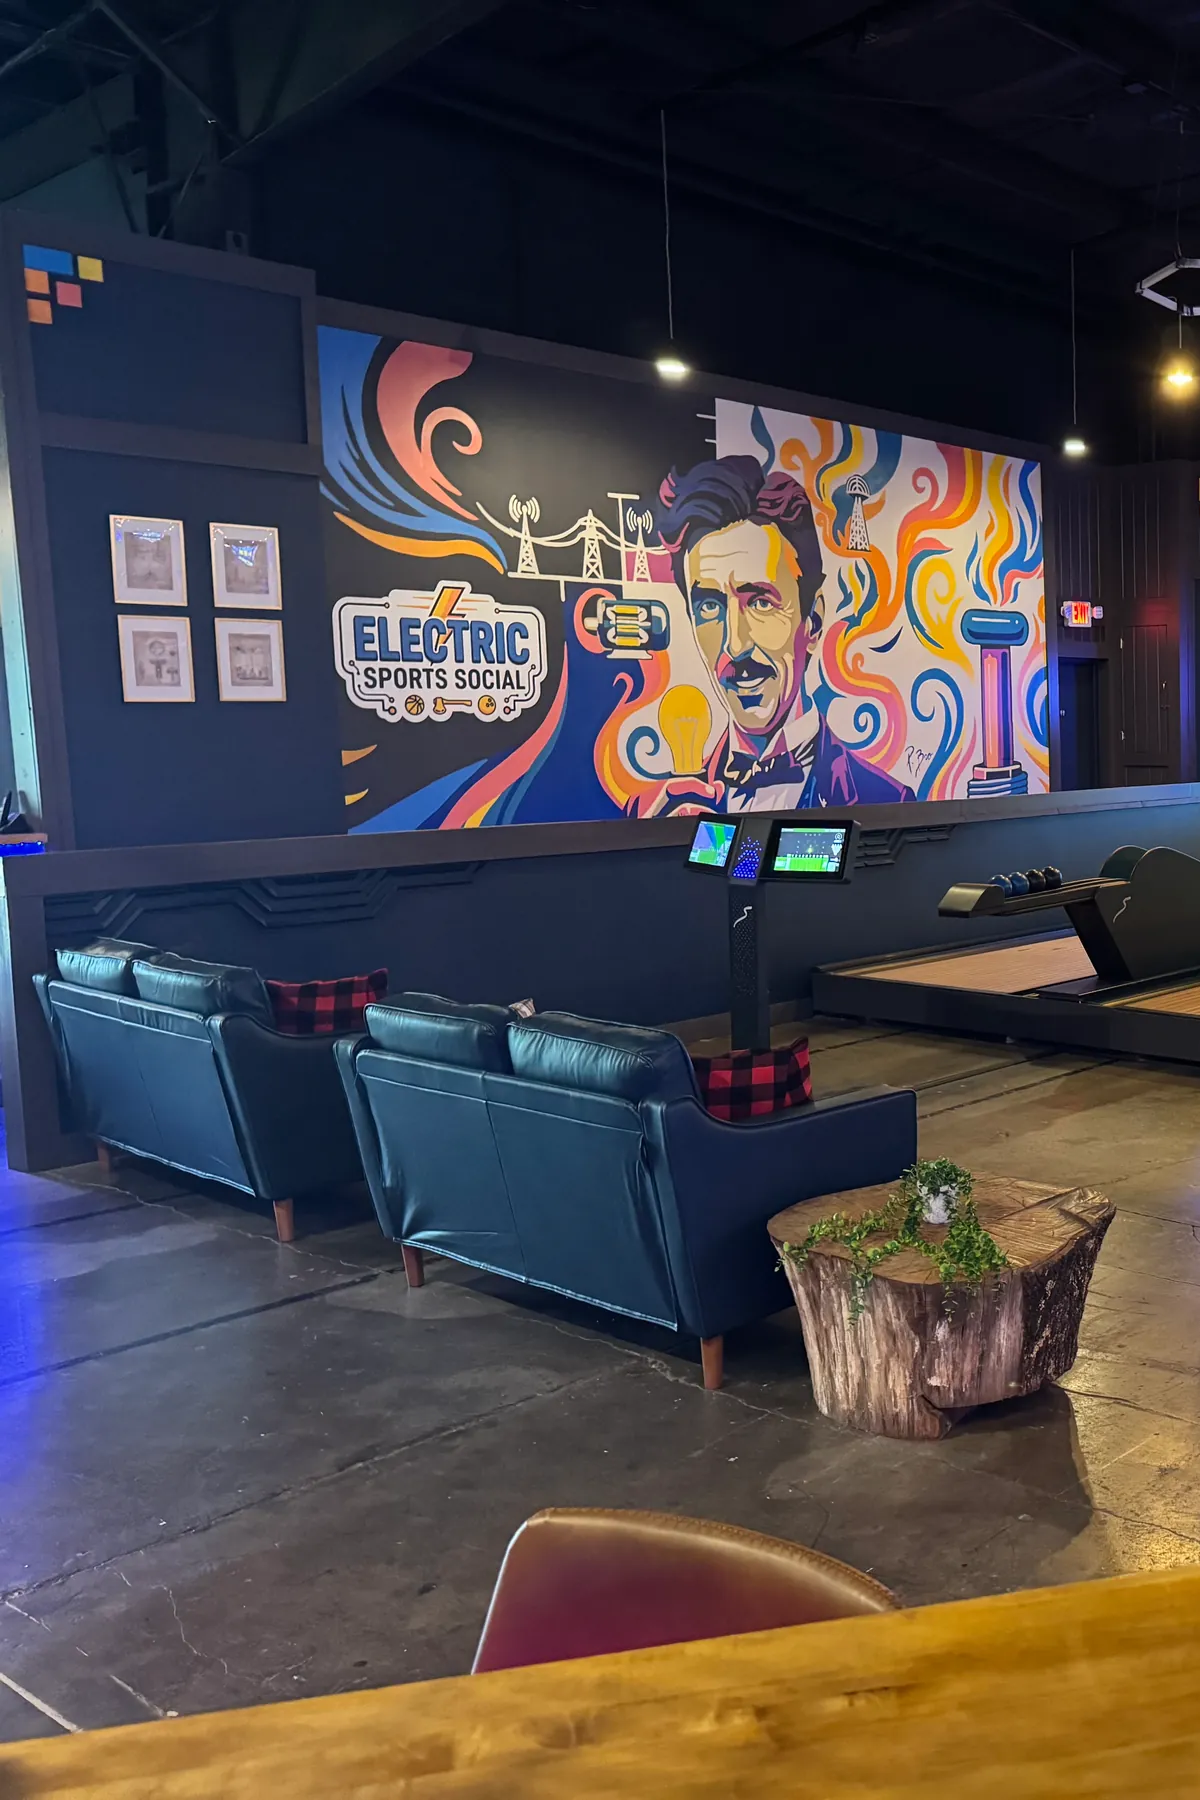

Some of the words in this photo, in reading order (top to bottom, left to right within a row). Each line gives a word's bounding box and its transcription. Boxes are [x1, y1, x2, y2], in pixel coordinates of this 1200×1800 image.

[1072, 602, 1089, 624] EXIT
[353, 615, 530, 665] ELECTRIC
[363, 667, 448, 689] SPORTS
[454, 669, 526, 690] SOCIAL
